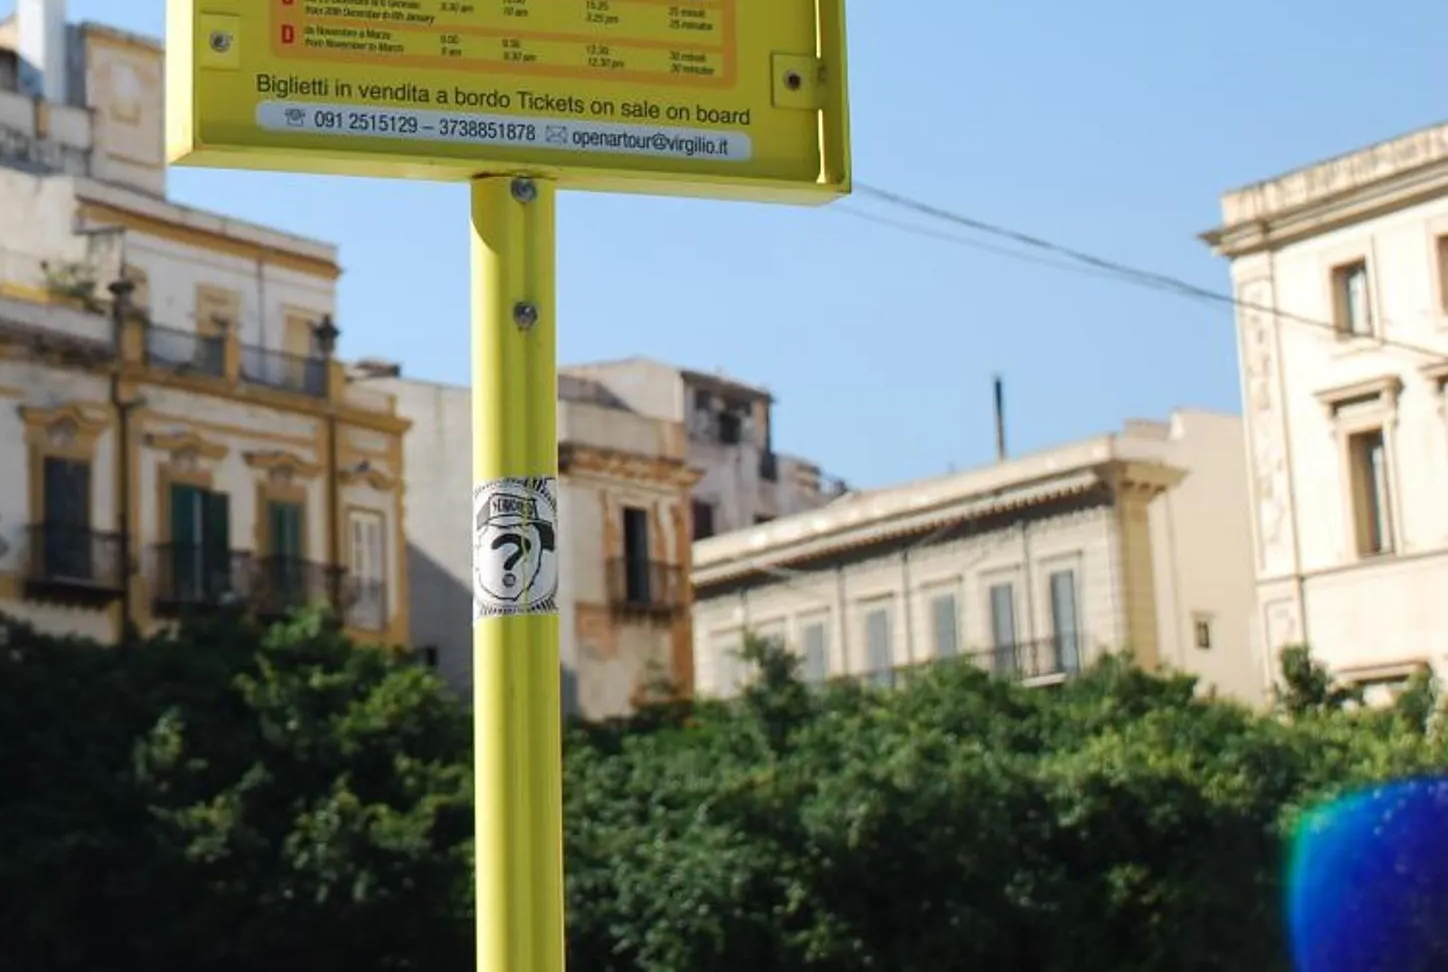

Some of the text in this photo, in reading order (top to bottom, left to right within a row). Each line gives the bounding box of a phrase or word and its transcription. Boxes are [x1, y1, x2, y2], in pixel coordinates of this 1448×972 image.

[281, 24, 294, 44] D
[256, 74, 751, 126] Biglietti in vendita a bordo Tickets on sale on board
[314, 110, 343, 129] 091
[349, 112, 418, 135] 2515129
[439, 118, 536, 141] 3738851878
[572, 129, 728, 157] openartour@virgilio.it
